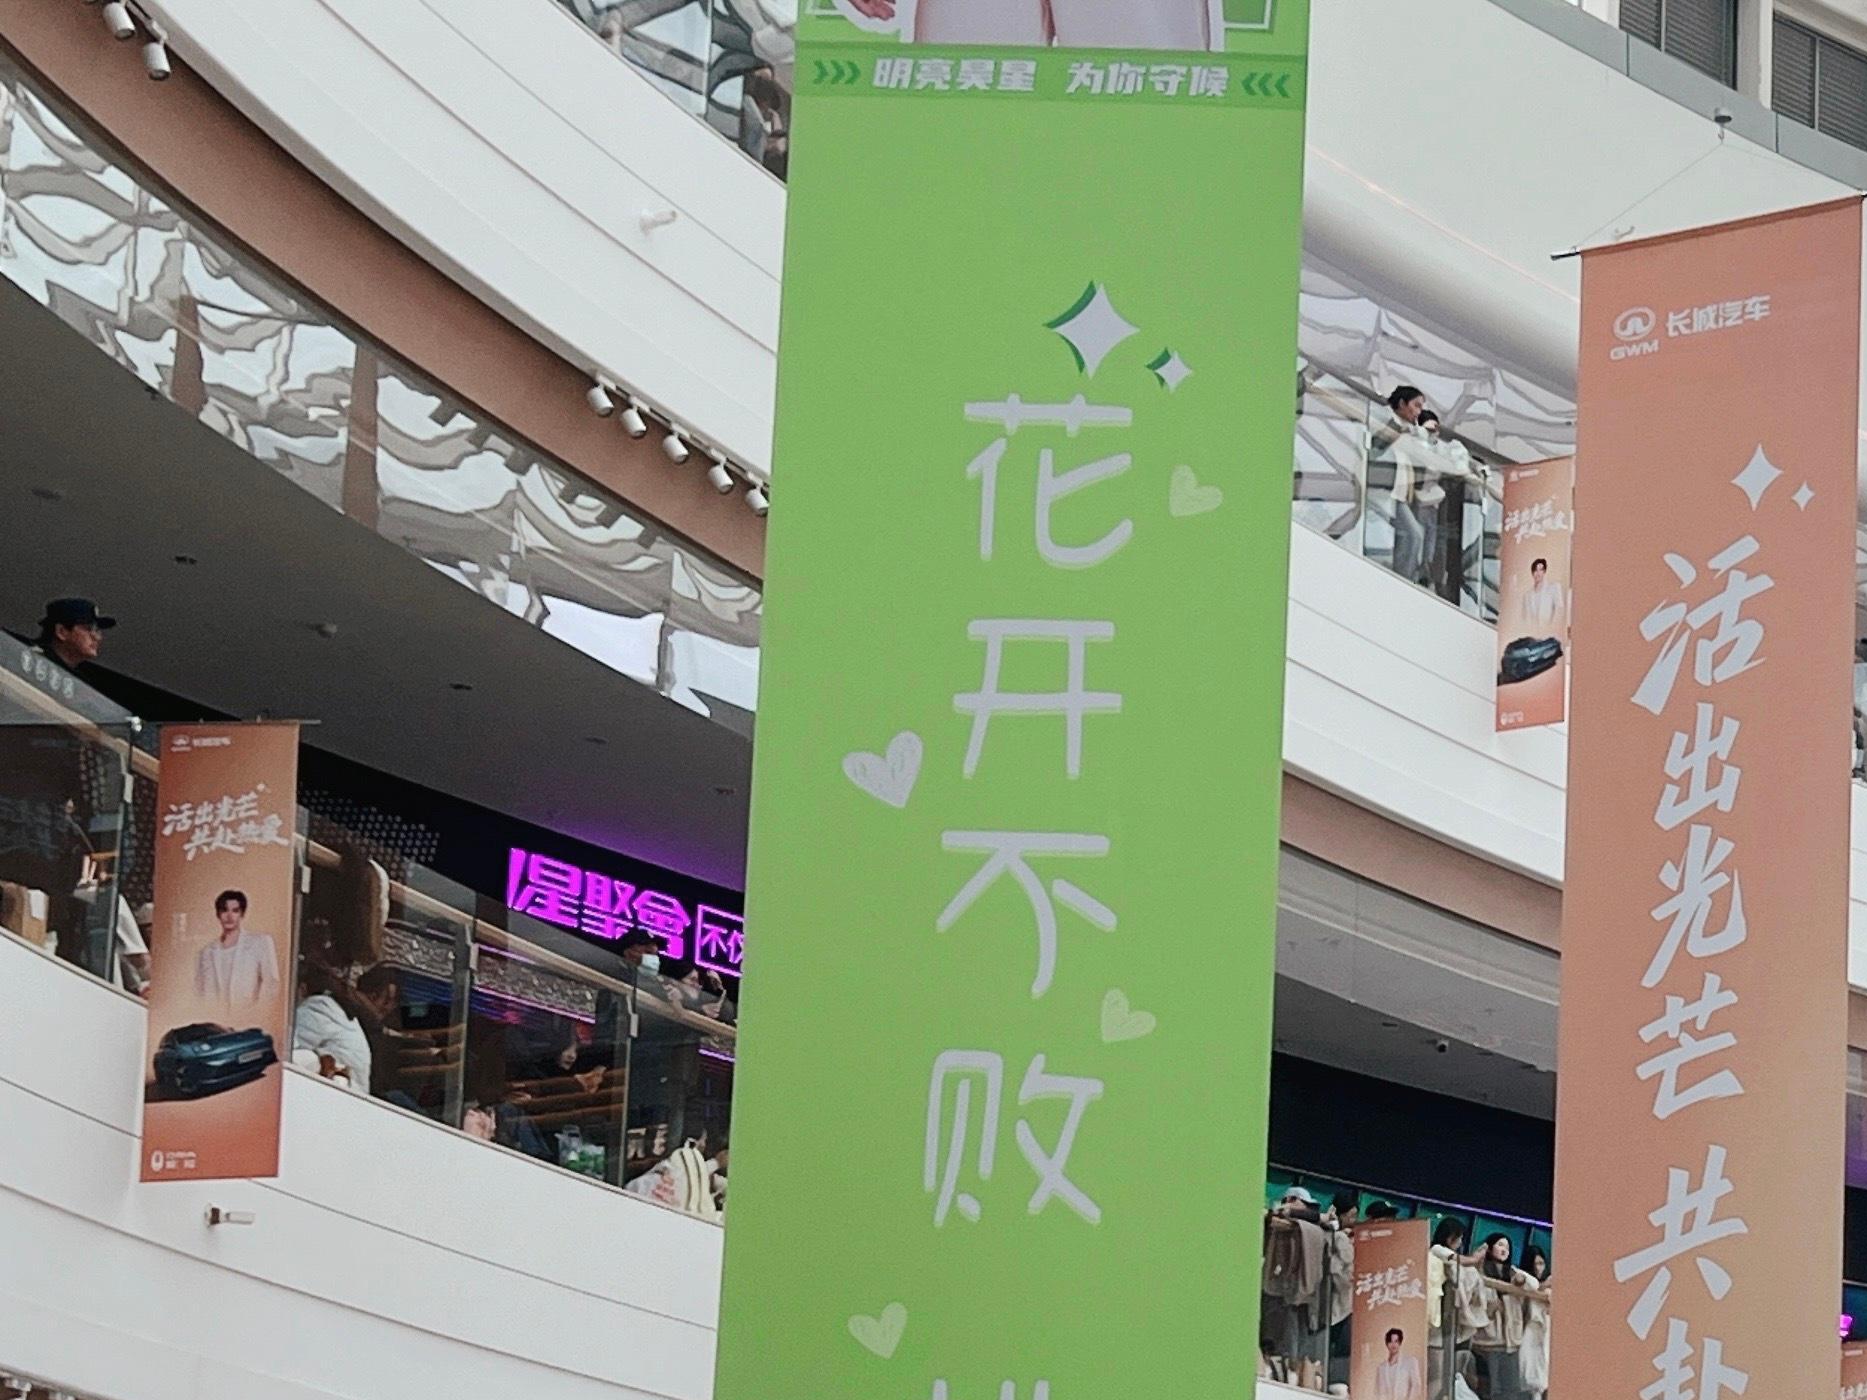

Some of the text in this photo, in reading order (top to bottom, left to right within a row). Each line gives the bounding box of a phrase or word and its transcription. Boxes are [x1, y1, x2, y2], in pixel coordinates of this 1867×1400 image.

[873, 58, 1229, 96] 明亮昊星 为你守候
[1666, 295, 1771, 337] 长城汽车
[1609, 339, 1659, 361] GWM
[922, 393, 1133, 1228] 花开不败
